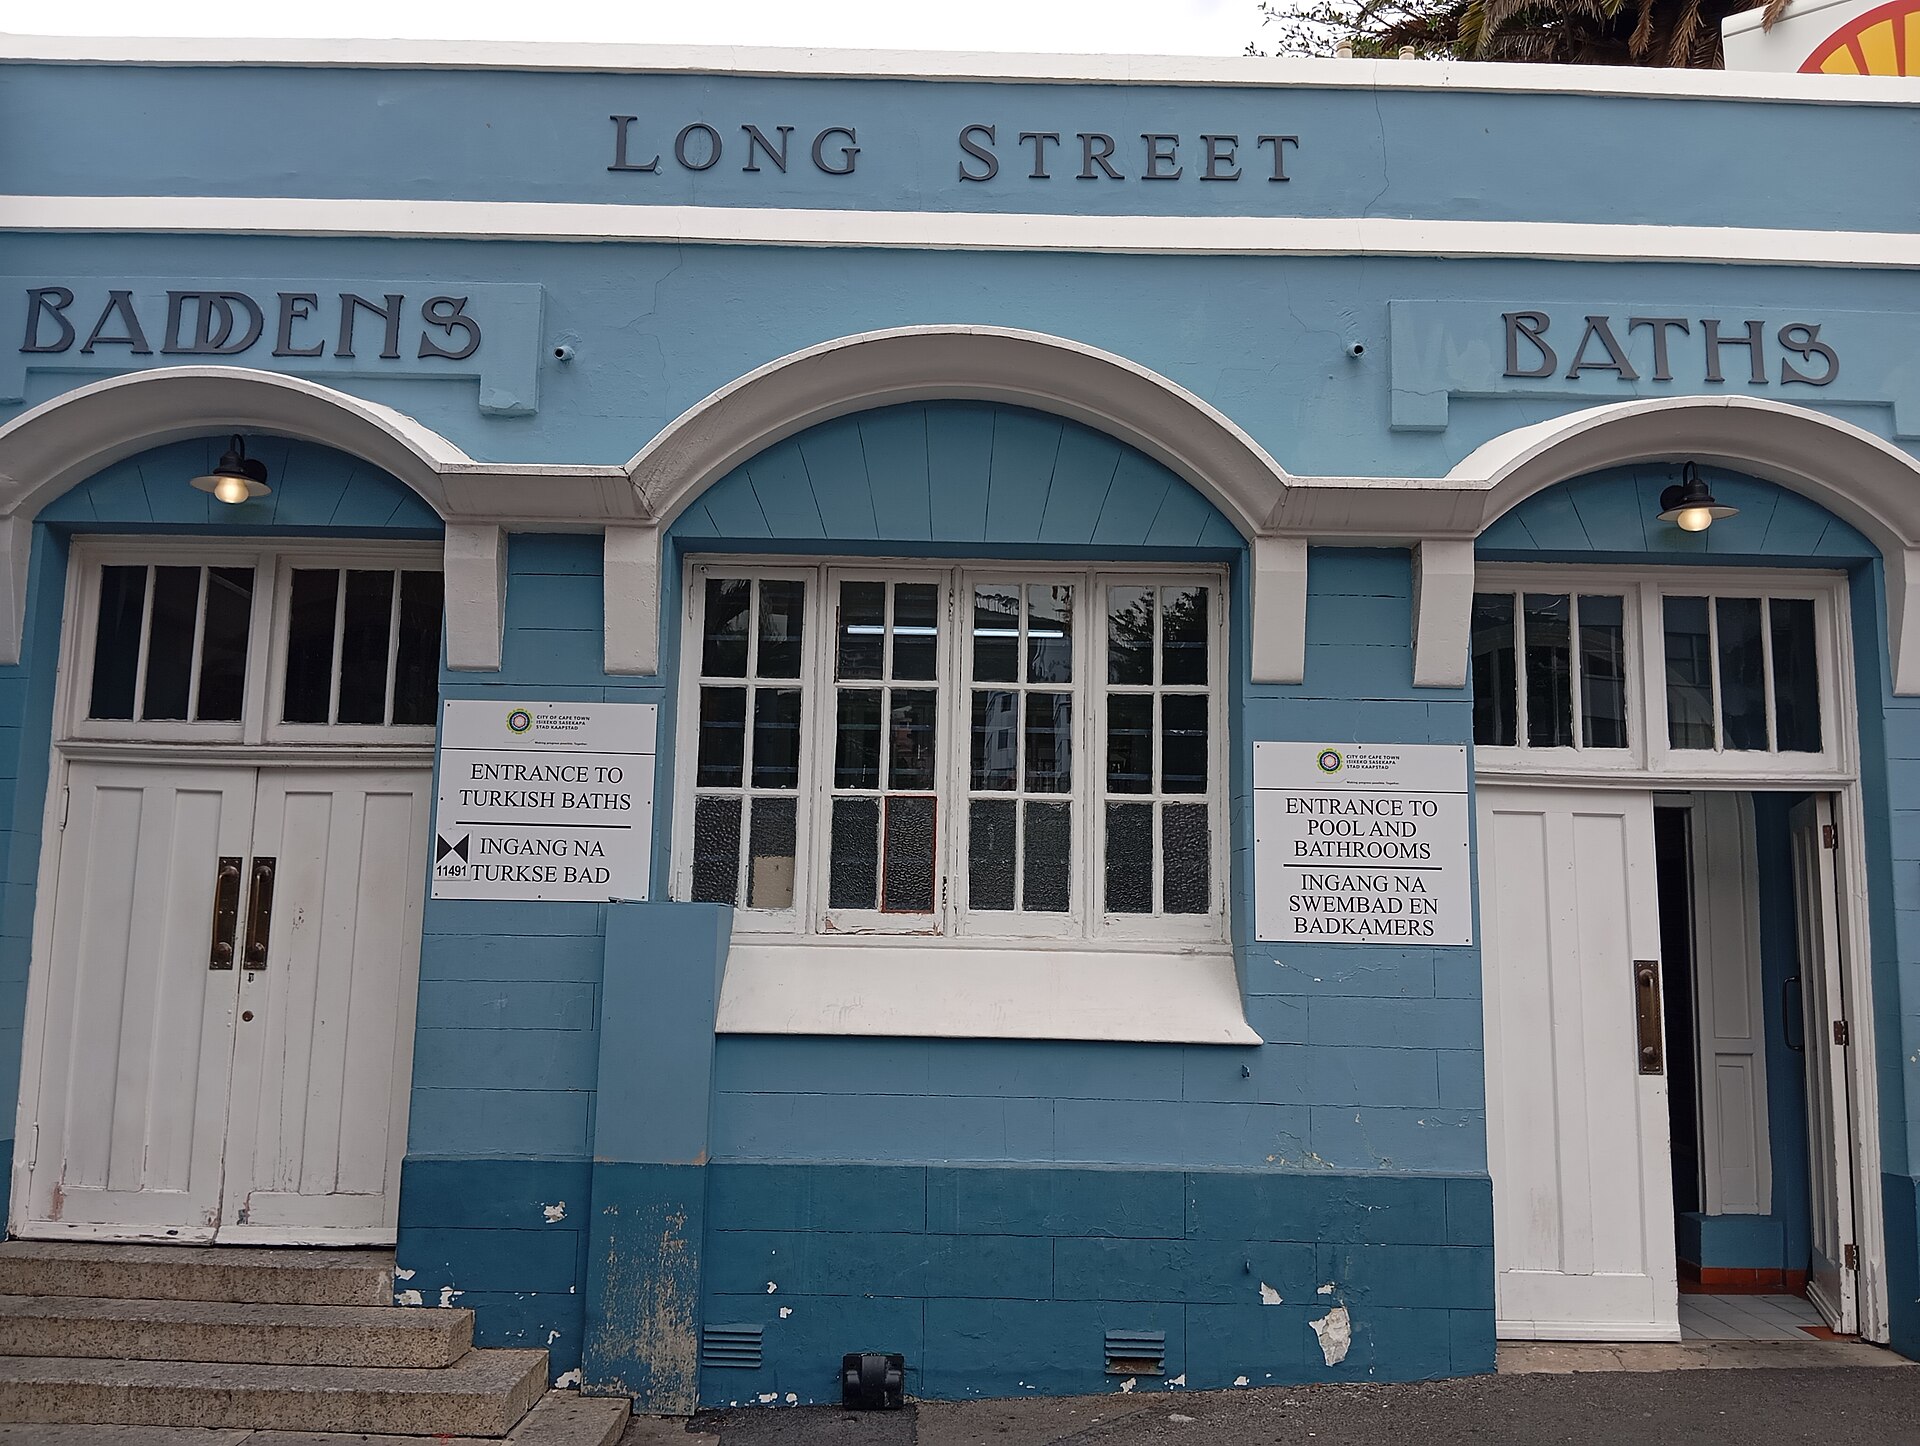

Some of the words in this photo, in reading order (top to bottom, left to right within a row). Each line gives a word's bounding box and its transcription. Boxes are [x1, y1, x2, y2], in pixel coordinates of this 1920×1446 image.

[607, 113, 862, 176] LONG
[958, 123, 1300, 183] STREET
[19, 286, 482, 360] BADDENS
[1501, 310, 1840, 387] BATHS
[470, 763, 589, 783] ENTRANCE
[595, 766, 624, 784] TO
[459, 789, 556, 809] TURKISH
[561, 792, 632, 811] BATHS
[1285, 797, 1404, 816] ENTRANCE
[1408, 800, 1438, 817] TO
[1307, 819, 1365, 837] POOL
[1369, 820, 1417, 838] AND
[479, 837, 568, 856] INGANG
[573, 840, 606, 857] NA
[1294, 840, 1431, 860] BATHROOMS
[436, 865, 467, 877] 11491
[470, 864, 558, 883] TURKSE
[563, 866, 611, 884] BAD
[1301, 873, 1389, 893] INGANG
[1394, 875, 1427, 893] NA
[1289, 894, 1403, 914] SWEMBAD
[1409, 898, 1438, 915] EN
[1294, 916, 1435, 937] BADKAMERS
